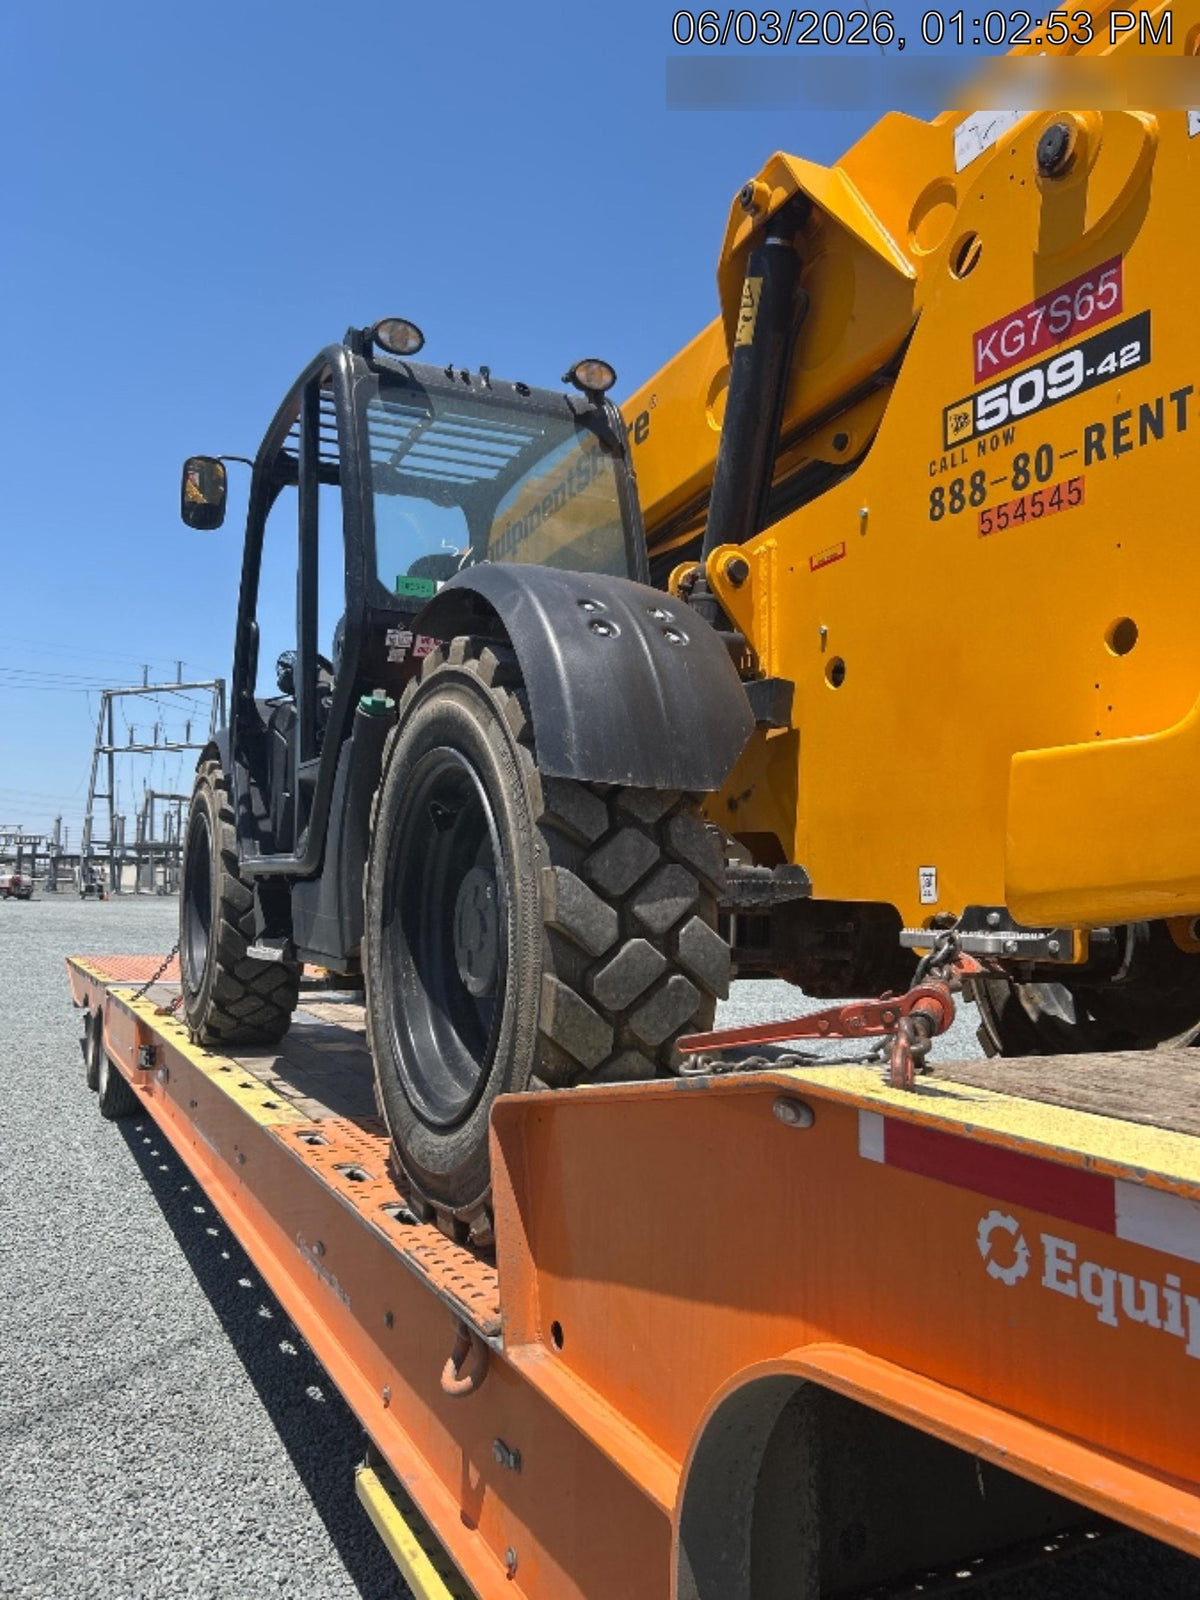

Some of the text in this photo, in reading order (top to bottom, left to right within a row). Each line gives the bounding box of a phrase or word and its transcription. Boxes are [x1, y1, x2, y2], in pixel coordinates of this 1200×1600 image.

[976, 268, 1119, 373] KG7S65
[976, 340, 1141, 431] 509-42
[928, 426, 1016, 478] CALL NOW
[928, 383, 1200, 522] 888-80-RENT
[979, 477, 1083, 536] 554545
